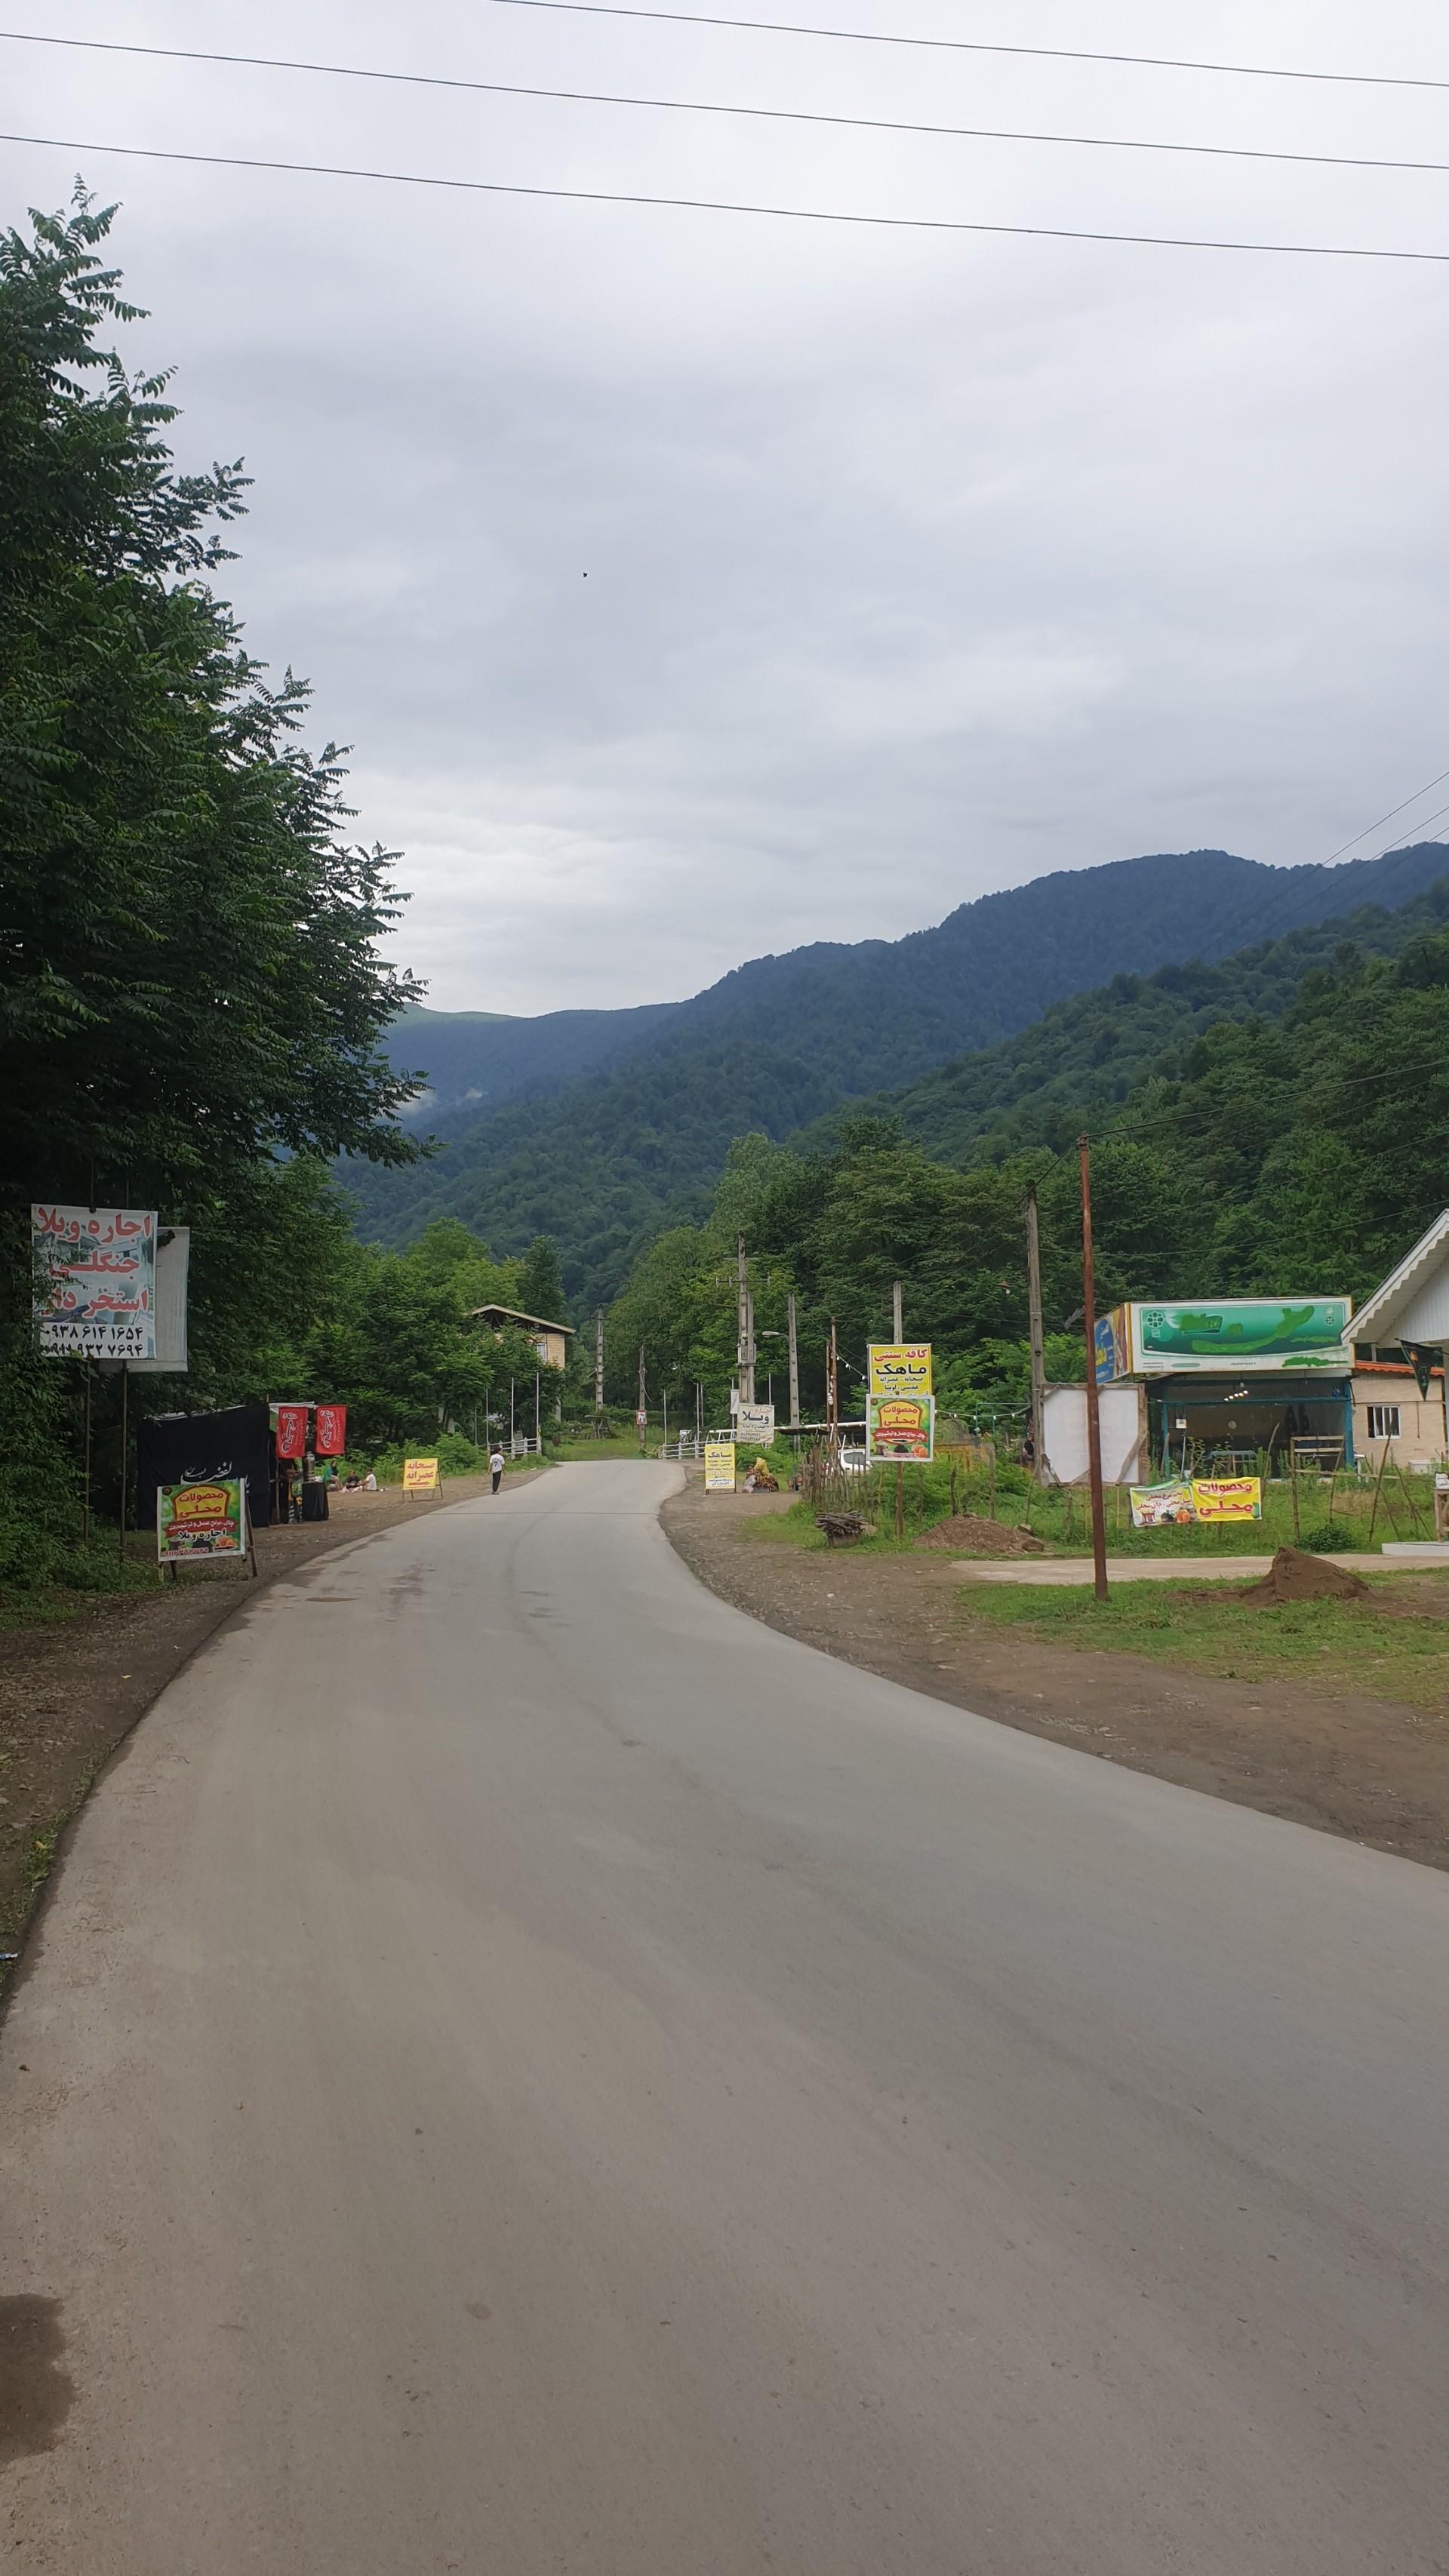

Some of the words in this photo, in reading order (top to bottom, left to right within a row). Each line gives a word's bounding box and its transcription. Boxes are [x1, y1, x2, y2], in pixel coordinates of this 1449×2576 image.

[38, 1207, 81, 1241] ویلا
[88, 1213, 151, 1243] اجاره
[48, 1250, 140, 1280] جنگلی
[82, 1288, 148, 1317] استخر
[874, 1351, 902, 1362] سنتی
[905, 1348, 928, 1359] کافه
[875, 1363, 927, 1374] ماهک
[884, 1406, 918, 1414] محصولات
[884, 1416, 916, 1426] محلی
[1198, 1482, 1253, 1496] محصولات
[179, 1492, 224, 1503] محصولات
[180, 1505, 222, 1518] محلی
[1199, 1500, 1254, 1517] محلی
